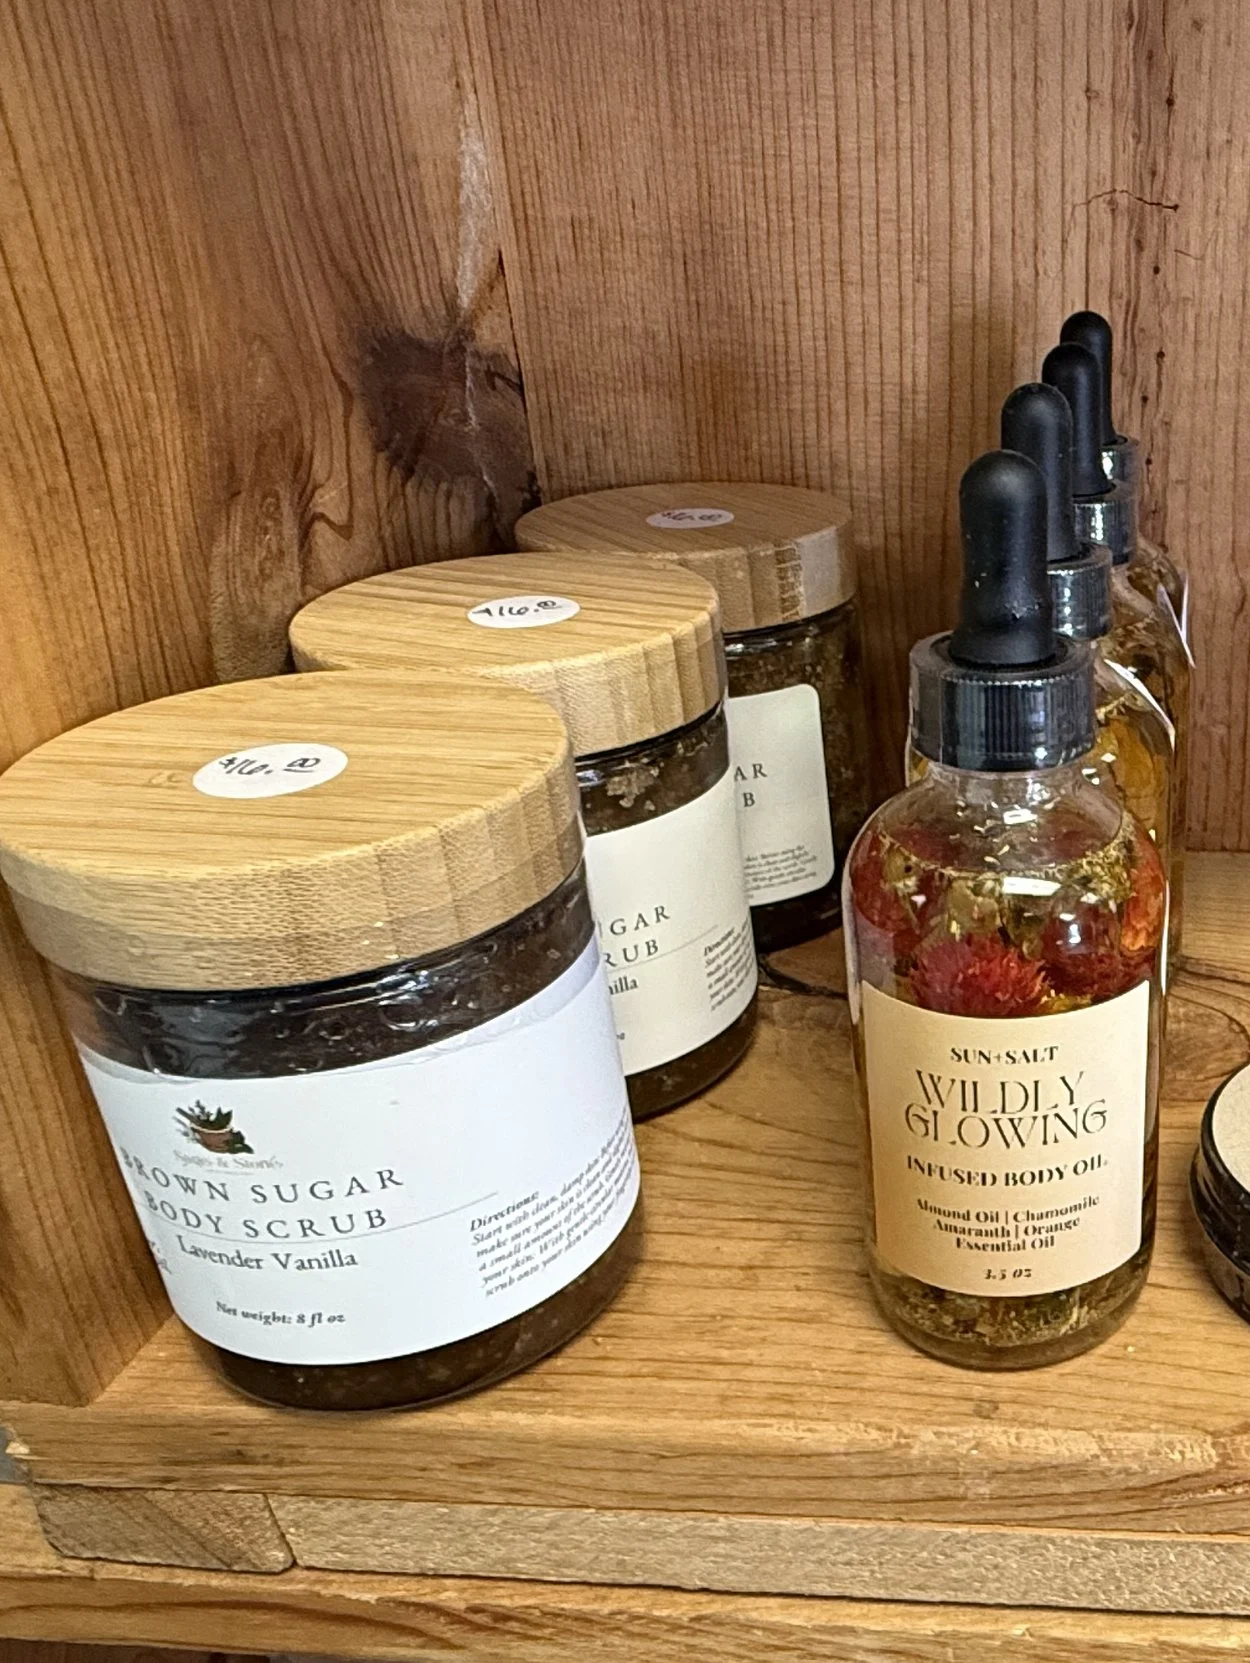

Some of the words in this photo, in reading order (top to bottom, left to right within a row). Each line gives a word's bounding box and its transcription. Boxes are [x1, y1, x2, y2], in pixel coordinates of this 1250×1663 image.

[609, 905, 670, 936] GAR
[603, 939, 658, 967] RUB
[950, 1046, 1059, 1064] SUN+SALT
[916, 1069, 1085, 1114] WILDLY
[905, 1099, 1107, 1149] GLOWING
[120, 1146, 230, 1201] BROWN
[250, 1169, 404, 1203] SUGAR
[907, 1155, 997, 1187] INFUSED
[1004, 1164, 1068, 1187] BODY
[1072, 1154, 1109, 1176] OIL
[144, 1190, 223, 1234] BODY
[243, 1209, 386, 1239] SCRUB
[470, 1192, 537, 1231] Directions:
[917, 1198, 971, 1222] Almond
[975, 1210, 1000, 1223] Oil
[1012, 1195, 1100, 1224] Chamomile
[473, 1225, 501, 1245] Start
[505, 1210, 529, 1229] with
[476, 1238, 507, 1257] make
[510, 1225, 531, 1241] sure
[534, 1210, 555, 1229] your
[934, 1219, 1010, 1238] Amaranth
[1024, 1216, 1080, 1236] Orange
[956, 1237, 1026, 1252] Essential
[1031, 1235, 1055, 1250] Oil
[177, 1235, 264, 1270] Lavender
[270, 1249, 358, 1271] Vanilla
[490, 1243, 520, 1266] small
[216, 1301, 237, 1316] Net
[241, 1310, 292, 1325] weight:
[296, 1314, 306, 1325] 8
[308, 1312, 322, 1328] fl
[327, 1315, 346, 1324] oz
